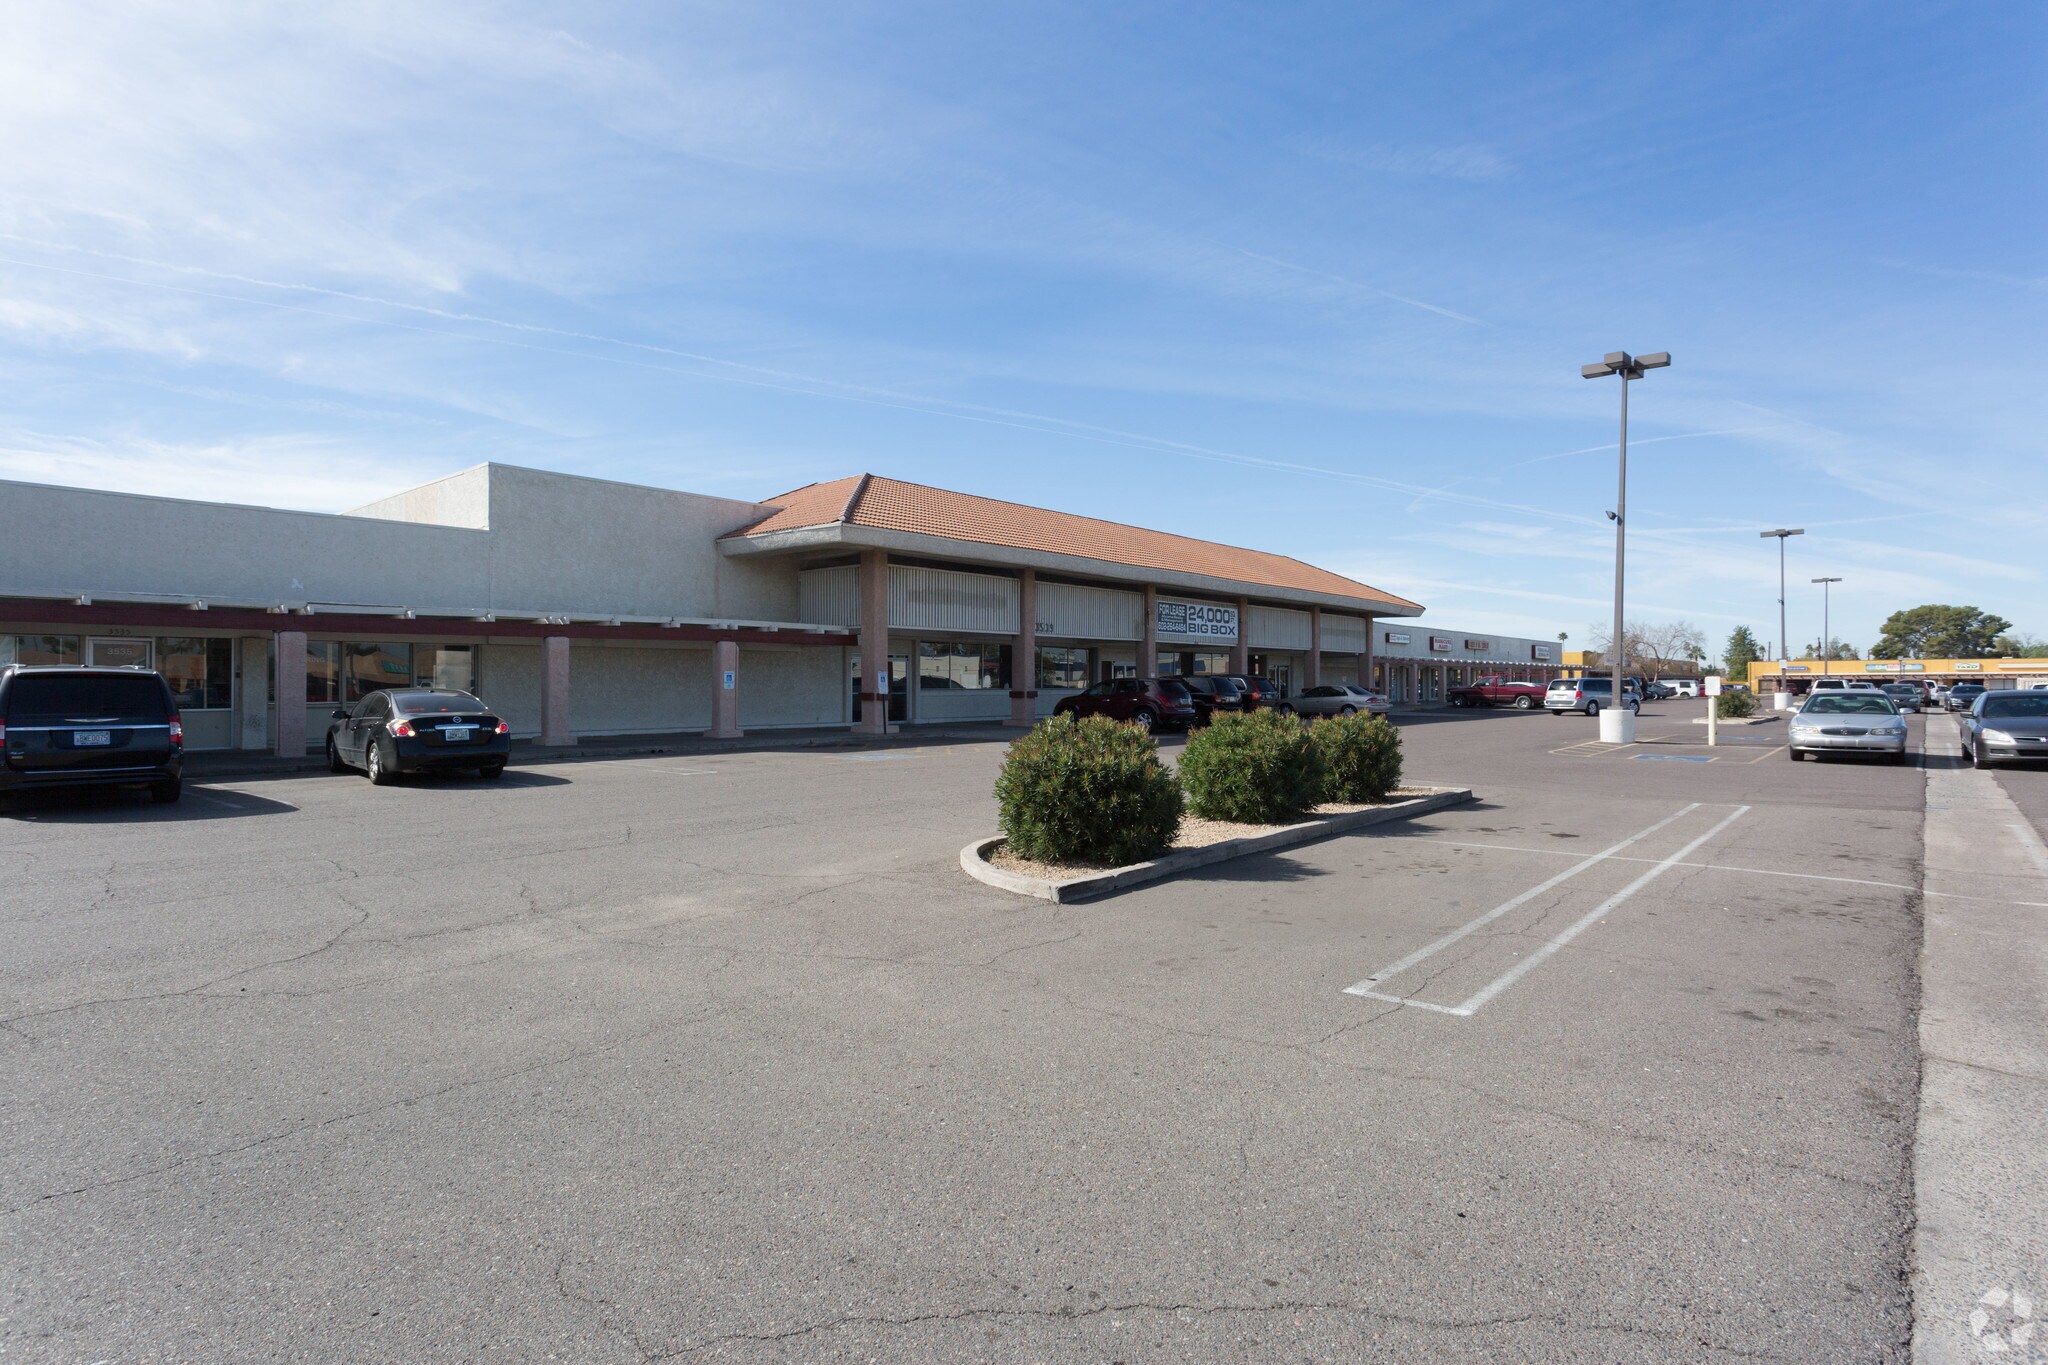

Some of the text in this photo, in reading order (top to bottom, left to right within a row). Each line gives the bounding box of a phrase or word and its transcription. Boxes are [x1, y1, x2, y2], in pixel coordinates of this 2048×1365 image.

[1159, 604, 1186, 616] FOR LEASE
[1188, 605, 1231, 624] 24,000
[1035, 622, 1053, 633] 3539
[1188, 622, 1236, 636] BIG BOX
[107, 647, 133, 656] 3535
